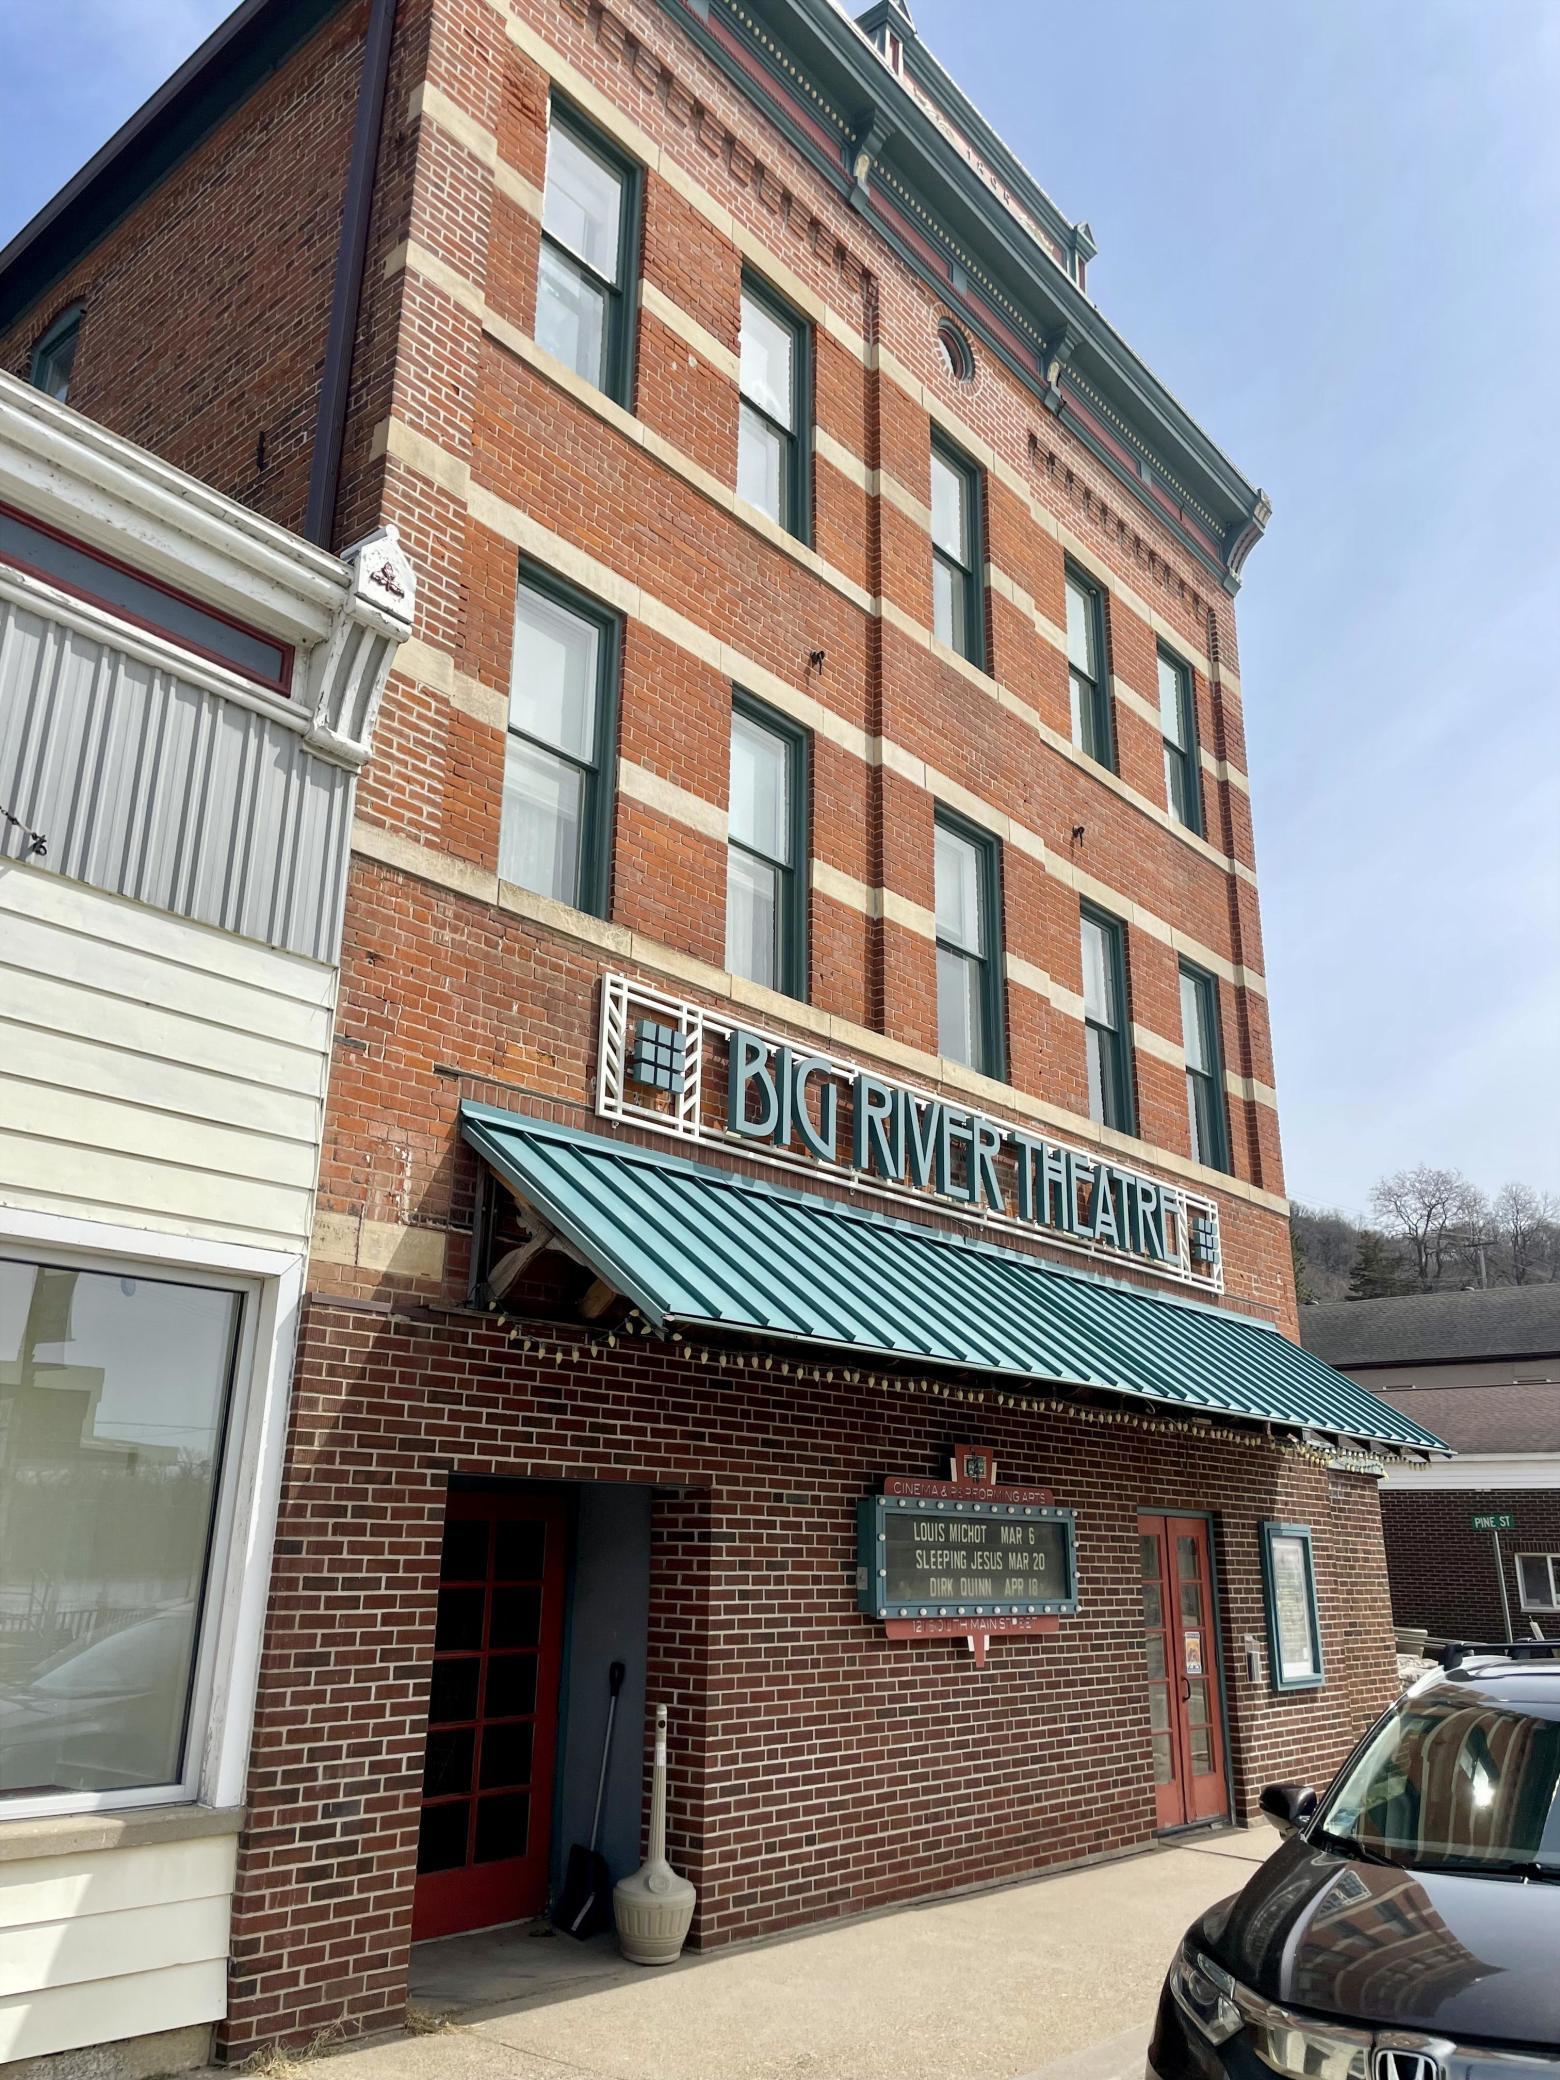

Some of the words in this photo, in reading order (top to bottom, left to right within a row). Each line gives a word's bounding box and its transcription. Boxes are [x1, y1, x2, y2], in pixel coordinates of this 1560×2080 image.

[727, 1030, 837, 1162] BIG
[853, 1075, 1004, 1211] RIVER
[1009, 1131, 1181, 1265] THEATRE
[893, 1481, 938, 1496] CINEMA
[940, 1486, 947, 1497] &
[1022, 1492, 1045, 1504] ARTS
[913, 1521, 945, 1542] LOUIS
[949, 1523, 987, 1543] MICHOT
[1000, 1526, 1022, 1545] MAR
[1028, 1527, 1035, 1545] 6
[1474, 1517, 1496, 1529] PINE
[1500, 1516, 1510, 1527] ST
[915, 1549, 967, 1570] SLEEPING
[971, 1551, 1003, 1570] JESUS
[1008, 1552, 1029, 1570] MAR
[1032, 1553, 1045, 1570] 20
[929, 1577, 954, 1597] DIRK
[960, 1577, 992, 1597] QUINN
[1004, 1578, 1024, 1597] APR
[970, 1618, 997, 1631] MAIN
